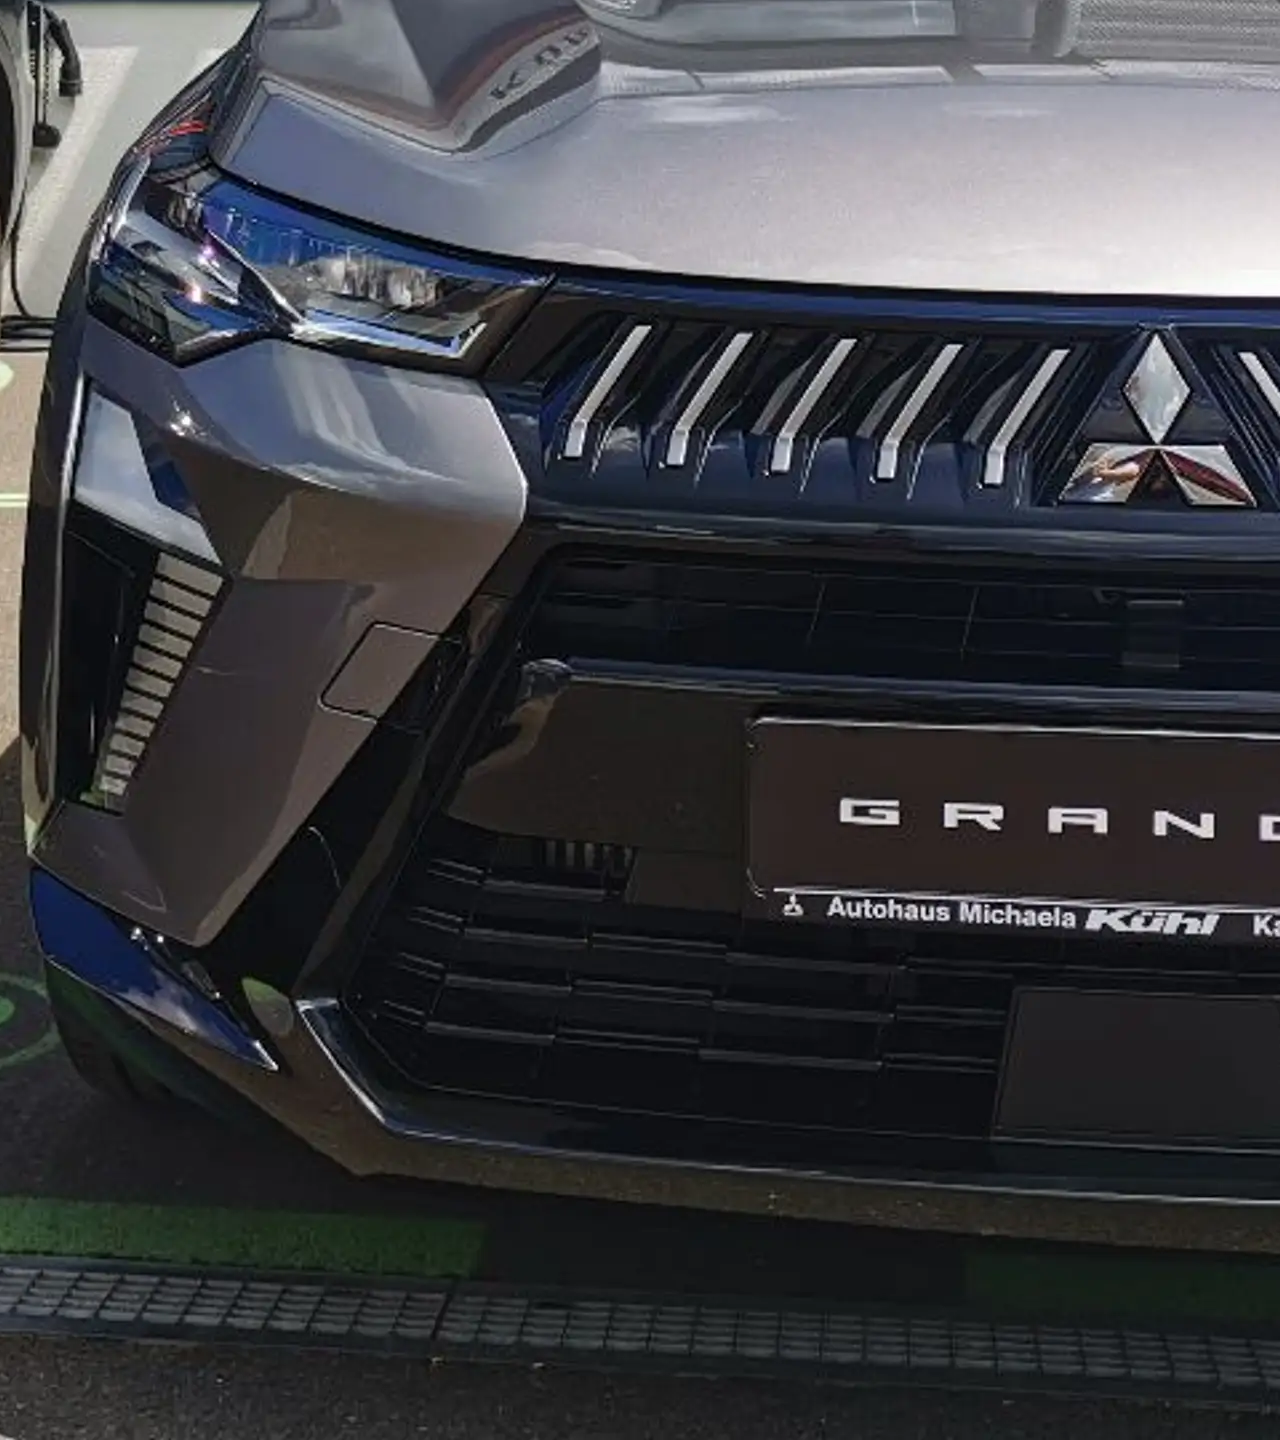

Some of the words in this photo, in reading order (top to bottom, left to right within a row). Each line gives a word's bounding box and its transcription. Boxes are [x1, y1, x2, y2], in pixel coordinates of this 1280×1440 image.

[827, 895, 951, 922] Autohaus
[959, 901, 1077, 929] Michaela
[1084, 907, 1220, 937] Kühl
